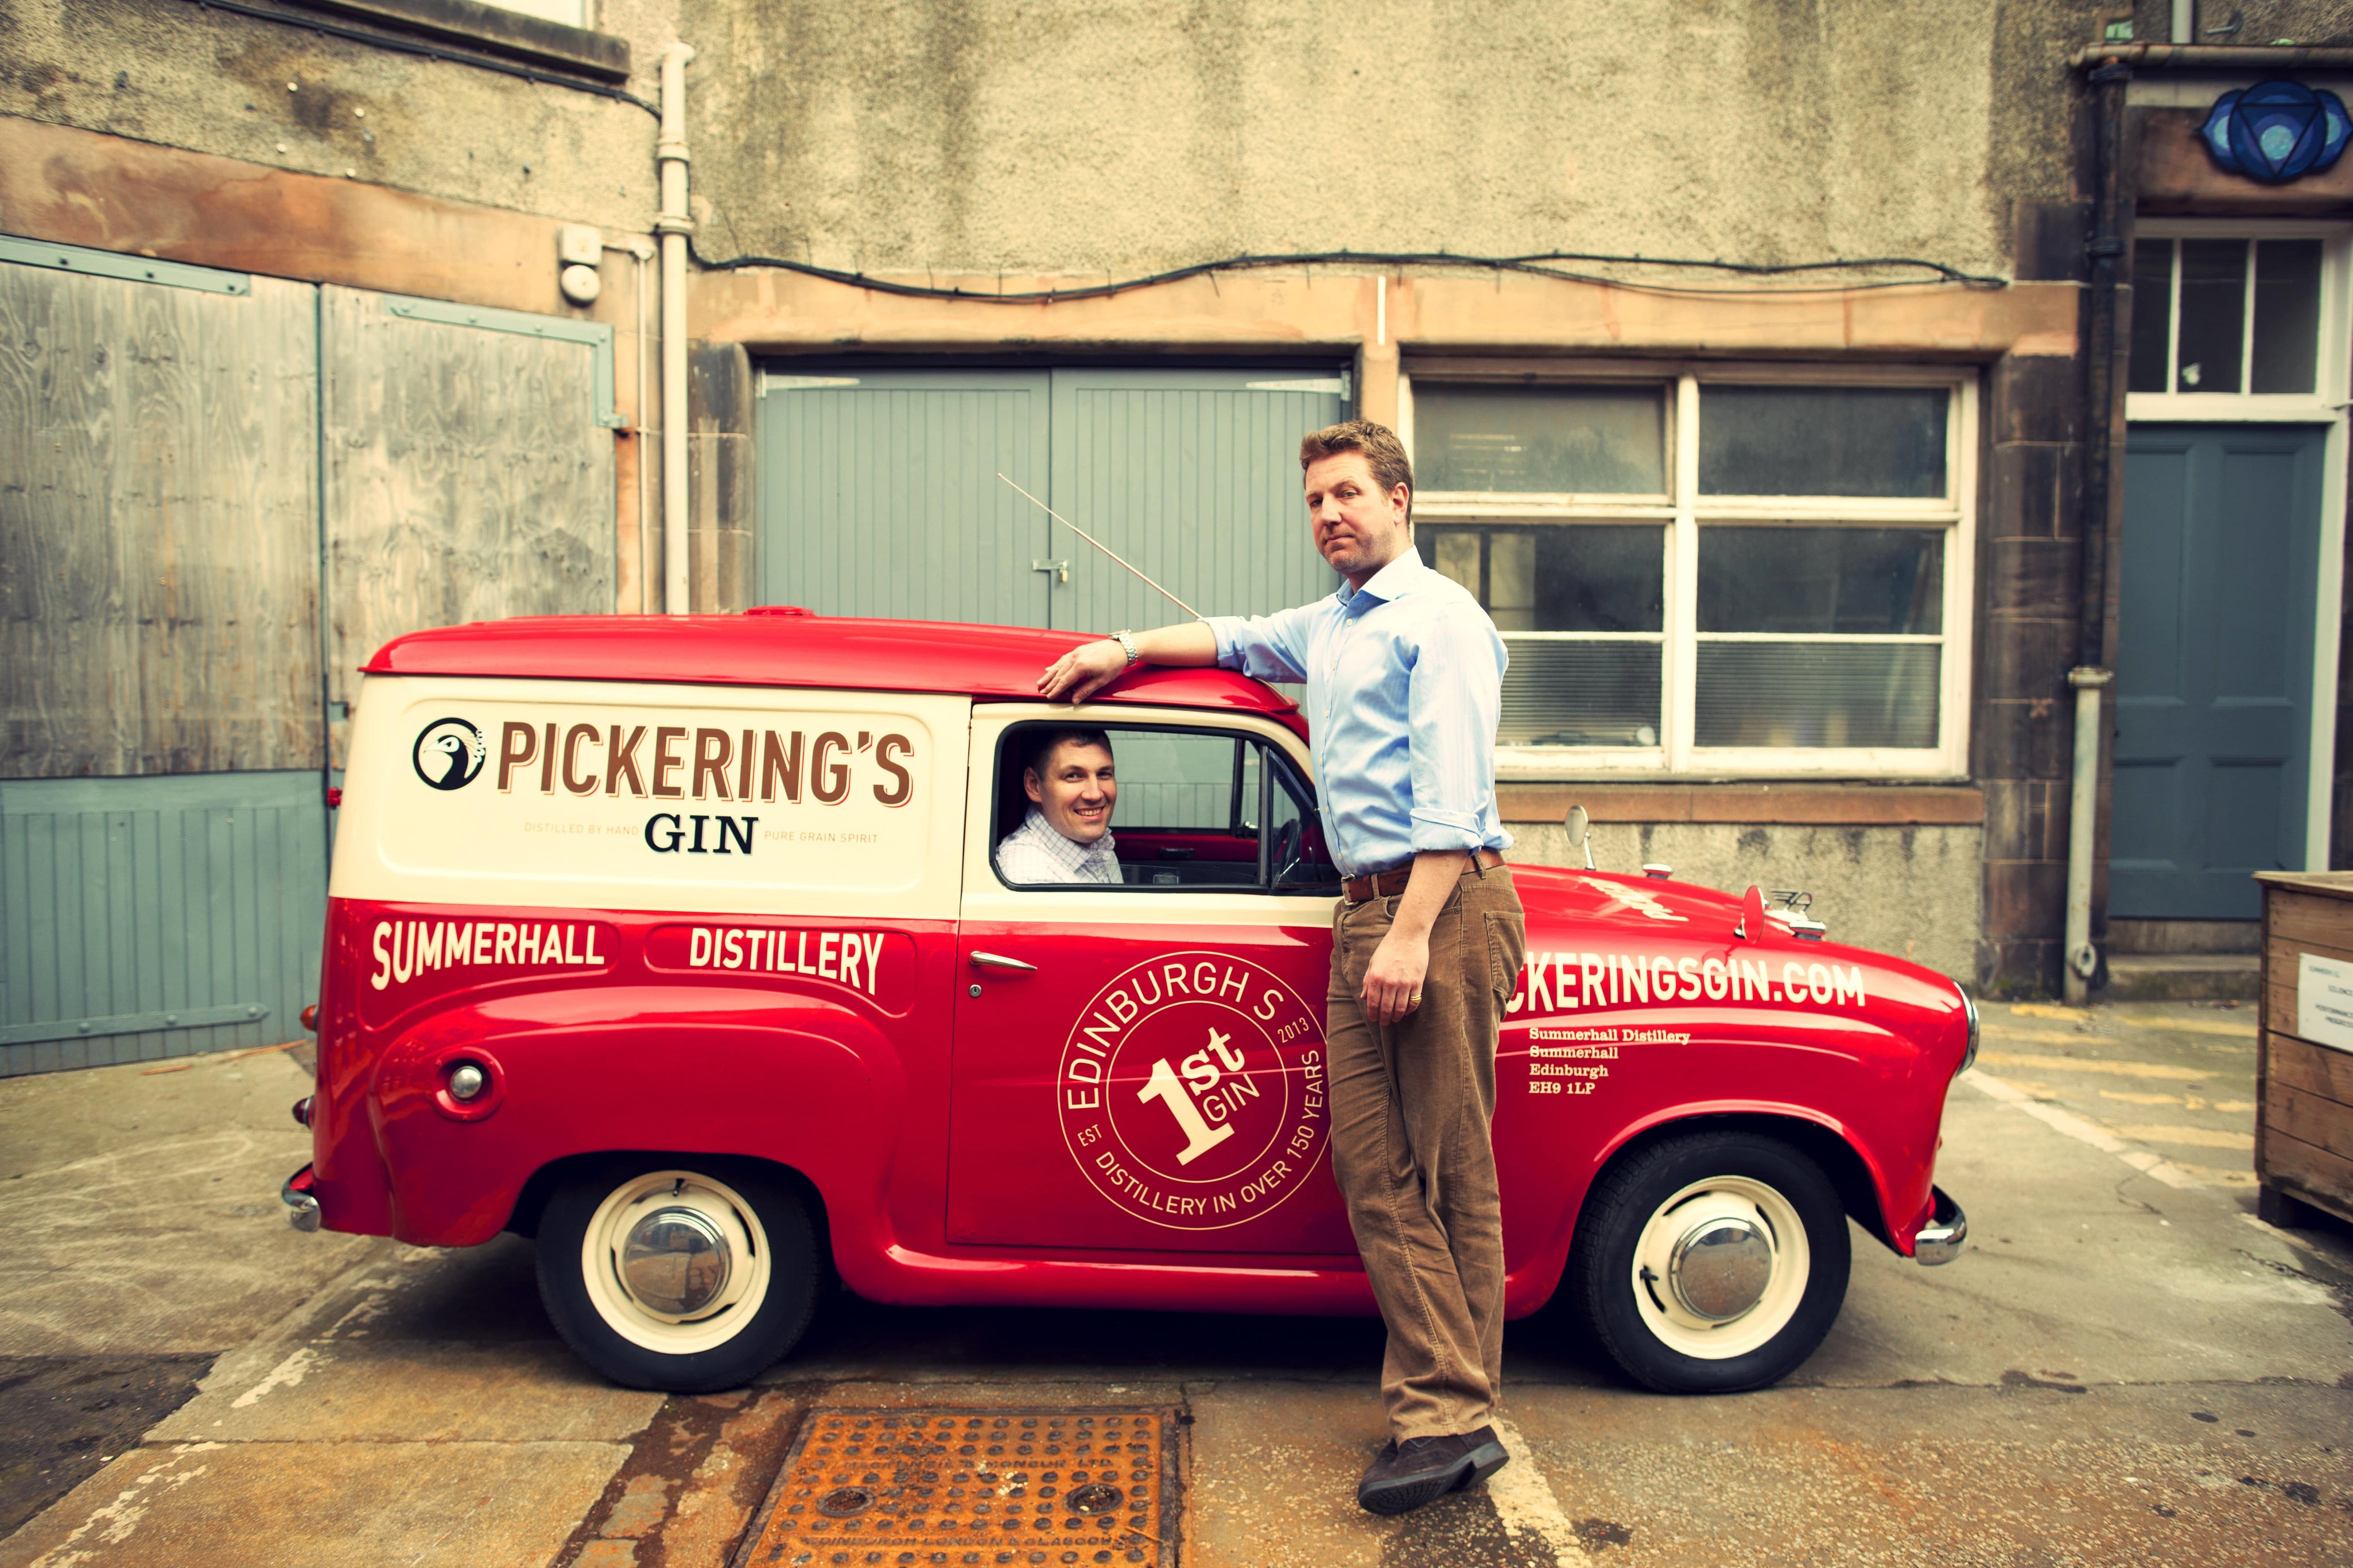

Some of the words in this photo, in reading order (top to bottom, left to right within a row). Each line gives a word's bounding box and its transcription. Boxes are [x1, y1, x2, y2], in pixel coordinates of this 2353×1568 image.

[497, 721, 915, 807] PICKERING'S
[525, 822, 584, 834] DISTILLED
[589, 823, 603, 835] BY
[607, 824, 639, 836] HAND
[644, 813, 759, 855] GIN
[765, 831, 795, 842] PURE
[799, 831, 836, 843] GRAIN
[841, 832, 879, 844] SPIRIT
[371, 920, 605, 991] SUMMERHALL
[689, 927, 884, 995] DISTILLERY
[1278, 1017, 1310, 1043] 2013
[1529, 1027, 1618, 1041] Summerhall
[1622, 1029, 1691, 1045] Distillery
[1529, 1045, 1618, 1059] Summerhall
[1529, 1063, 1609, 1077] Edinburgh
[1136, 1026, 1245, 1166] 1st
[1203, 1073, 1260, 1122] GIN
[1529, 1081, 1561, 1094] EH9
[1567, 1082, 1595, 1094] 1LP
[1077, 1125, 1102, 1147] EST
[1096, 1151, 1206, 1215] DISTILLERY
[1214, 1192, 1236, 1213] IN
[1240, 1161, 1292, 1203] OVER
[1287, 1126, 1315, 1159] 150
[1302, 1050, 1323, 1119] YEARS
